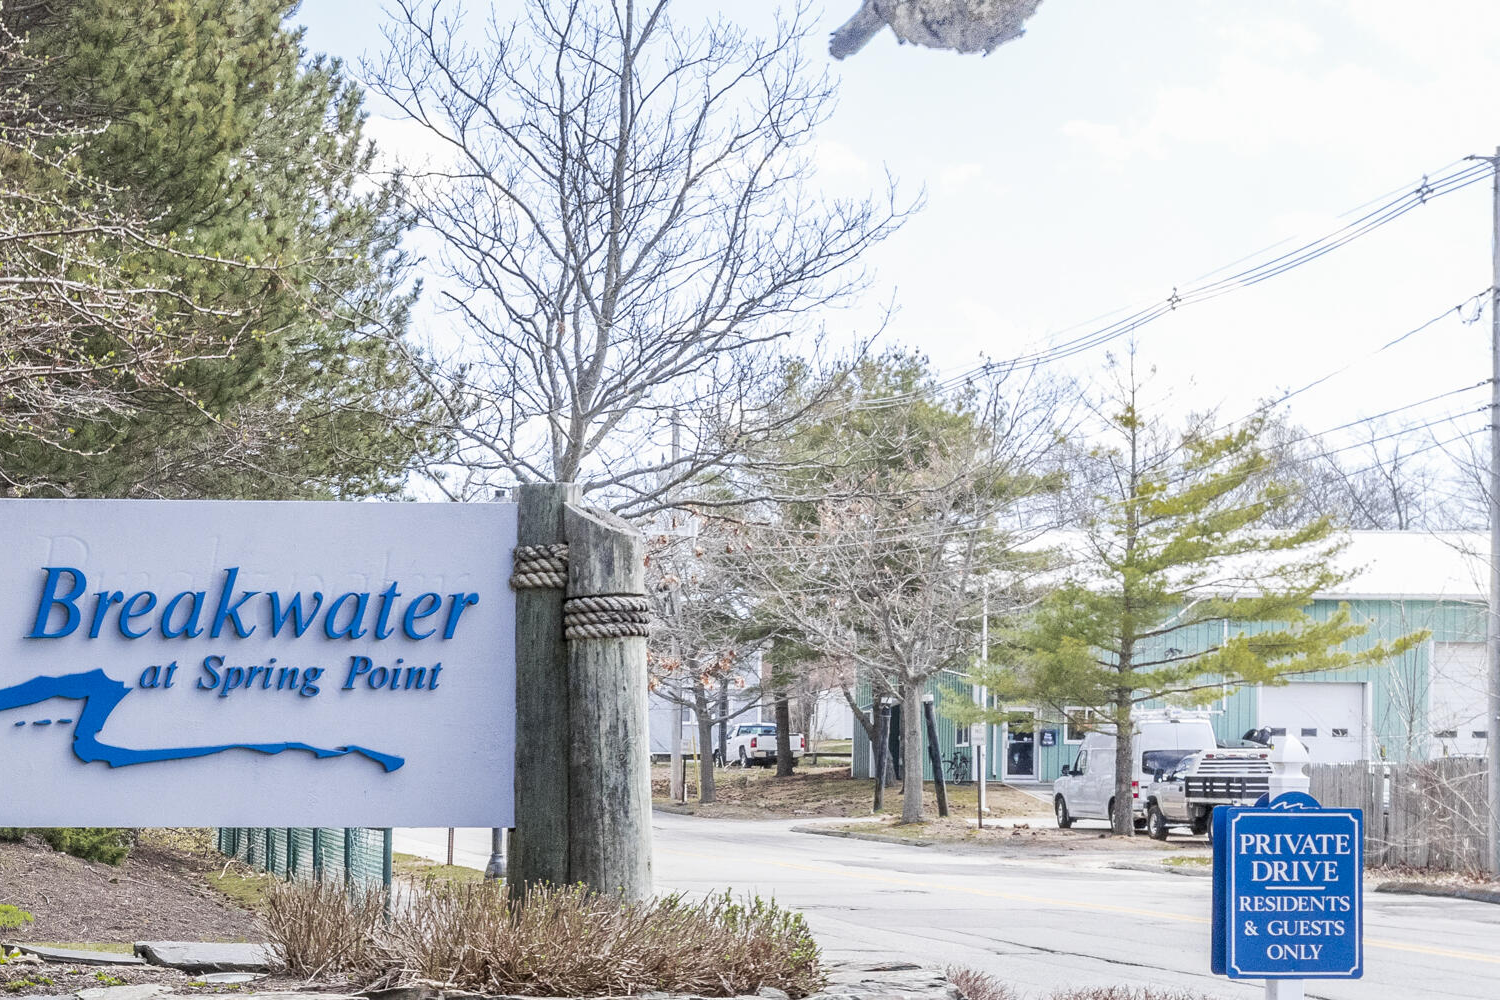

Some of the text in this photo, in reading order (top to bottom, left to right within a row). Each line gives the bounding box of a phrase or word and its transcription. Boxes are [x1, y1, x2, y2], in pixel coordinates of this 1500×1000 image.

[23, 566, 479, 641] Breakwater
[139, 655, 443, 698] at Spring Point
[1239, 833, 1351, 855] PRIVATE
[1251, 861, 1339, 882] DRIVE
[1239, 896, 1351, 912] RESIDENTS
[1244, 920, 1345, 936] & GUESTS
[1266, 944, 1323, 960] ONLY
